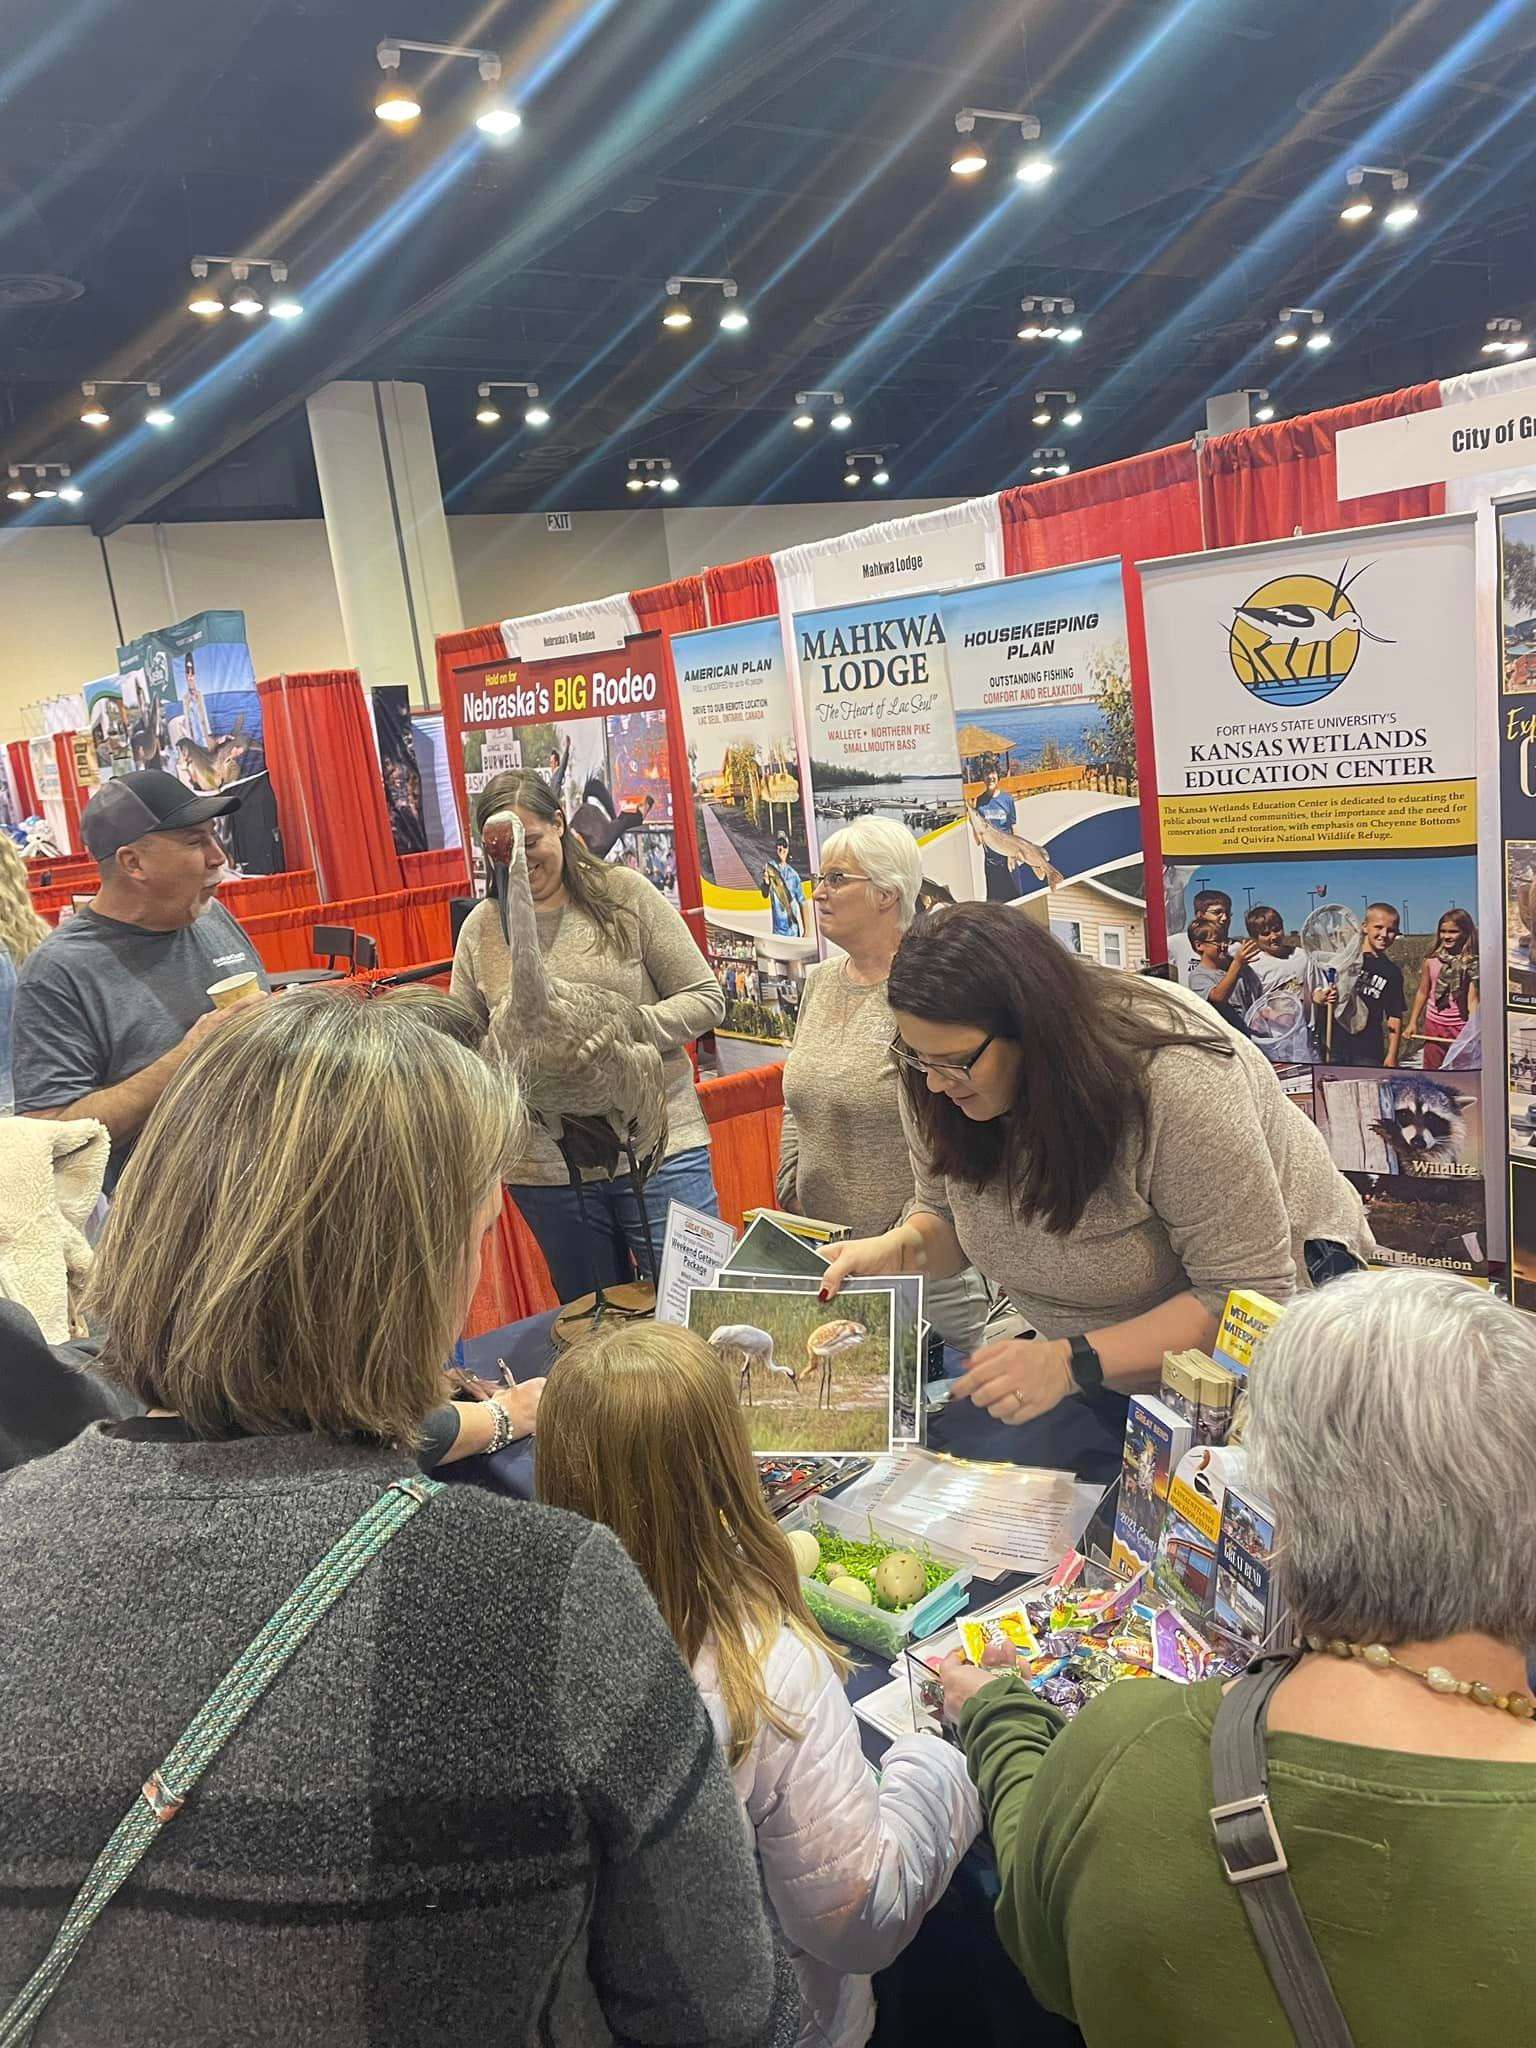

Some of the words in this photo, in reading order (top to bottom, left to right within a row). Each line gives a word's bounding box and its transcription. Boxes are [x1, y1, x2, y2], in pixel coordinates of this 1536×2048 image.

[1452, 427, 1490, 453] City
[1495, 419, 1516, 444] of
[547, 513, 569, 529] EXIT
[862, 561, 895, 578] Mahkwa
[896, 555, 923, 572] Lodge
[578, 630, 596, 642] Rodeo
[801, 612, 947, 662] MAHKWA
[964, 613, 1099, 648] HOUSEKEEPING
[1007, 639, 1055, 660] PLAN
[485, 673, 500, 686] Hold
[500, 674, 508, 684] on
[507, 671, 518, 683] for
[683, 663, 738, 682] AMERICAN
[742, 658, 772, 674] PLAN
[821, 652, 929, 694] LODGE
[989, 671, 1042, 688] OUTSTANDING
[1043, 667, 1074, 681] FISHING
[463, 682, 549, 723] Nebraska's
[553, 674, 588, 712] BIG
[592, 667, 657, 708] Rodeo
[744, 698, 768, 709] LOCATION
[983, 689, 1019, 704] COMFORT
[1020, 688, 1036, 701] AND
[1038, 682, 1083, 699] RELAXATION
[840, 700, 874, 721] Heart
[876, 697, 886, 720] of
[888, 696, 910, 716] Lac
[827, 728, 861, 741] WALLEYE
[871, 725, 912, 738] NORTHERN
[914, 723, 931, 735] PIKE
[1216, 724, 1247, 737] FORT
[1248, 721, 1278, 734] HAYS
[1281, 719, 1314, 732] STATE
[1317, 712, 1397, 729] UNIVERSITY'S
[843, 740, 895, 754] SMALLMOUTH
[897, 739, 917, 751] BASS
[1190, 738, 1283, 762] KANSAS
[1287, 728, 1428, 756] WETLANDS
[483, 753, 520, 770] BURWELL
[1185, 763, 1328, 789] EDUCATION
[1336, 756, 1436, 779] CENTER
[1163, 806, 1177, 814] The
[1178, 806, 1207, 814] Kansas
[1209, 803, 1250, 813] Wetlands
[1252, 800, 1296, 810] Education
[1298, 799, 1328, 808] Center
[1330, 797, 1339, 806] is
[1340, 795, 1384, 806] dedicated
[1387, 796, 1395, 804] to
[1398, 793, 1447, 804] educating
[1449, 791, 1465, 801] the
[1163, 817, 1185, 827] public
[1186, 817, 1210, 825] about
[1212, 814, 1247, 823] wetland
[1249, 811, 1308, 821] communities,
[1310, 810, 1332, 819] their
[1334, 808, 1386, 819] importance
[1387, 806, 1406, 816] and
[1408, 806, 1424, 815] the
[1425, 804, 1450, 814] need
[1452, 803, 1468, 813] for
[1167, 827, 1217, 836] conservation
[1218, 826, 1235, 834] and
[1237, 823, 1287, 833] restoration,
[1288, 822, 1309, 831] with
[1311, 821, 1354, 832] emphasis
[1370, 819, 1417, 829] Cheyenne
[1419, 817, 1461, 826] Bottoms
[1222, 837, 1239, 845] and
[1241, 836, 1275, 845] Quivira
[1276, 833, 1315, 842] National
[1317, 831, 1357, 841] Wildlife
[1358, 830, 1393, 841] Refuge.
[1412, 1160, 1478, 1176] Wildlife
[671, 1237, 697, 1258] Weekend
[683, 1255, 707, 1276] Package
[1396, 1252, 1473, 1271] Education
[1120, 1510, 1137, 1534] 2023
[1224, 1549, 1243, 1573] GREAT
[1244, 1562, 1262, 1588] BEND
